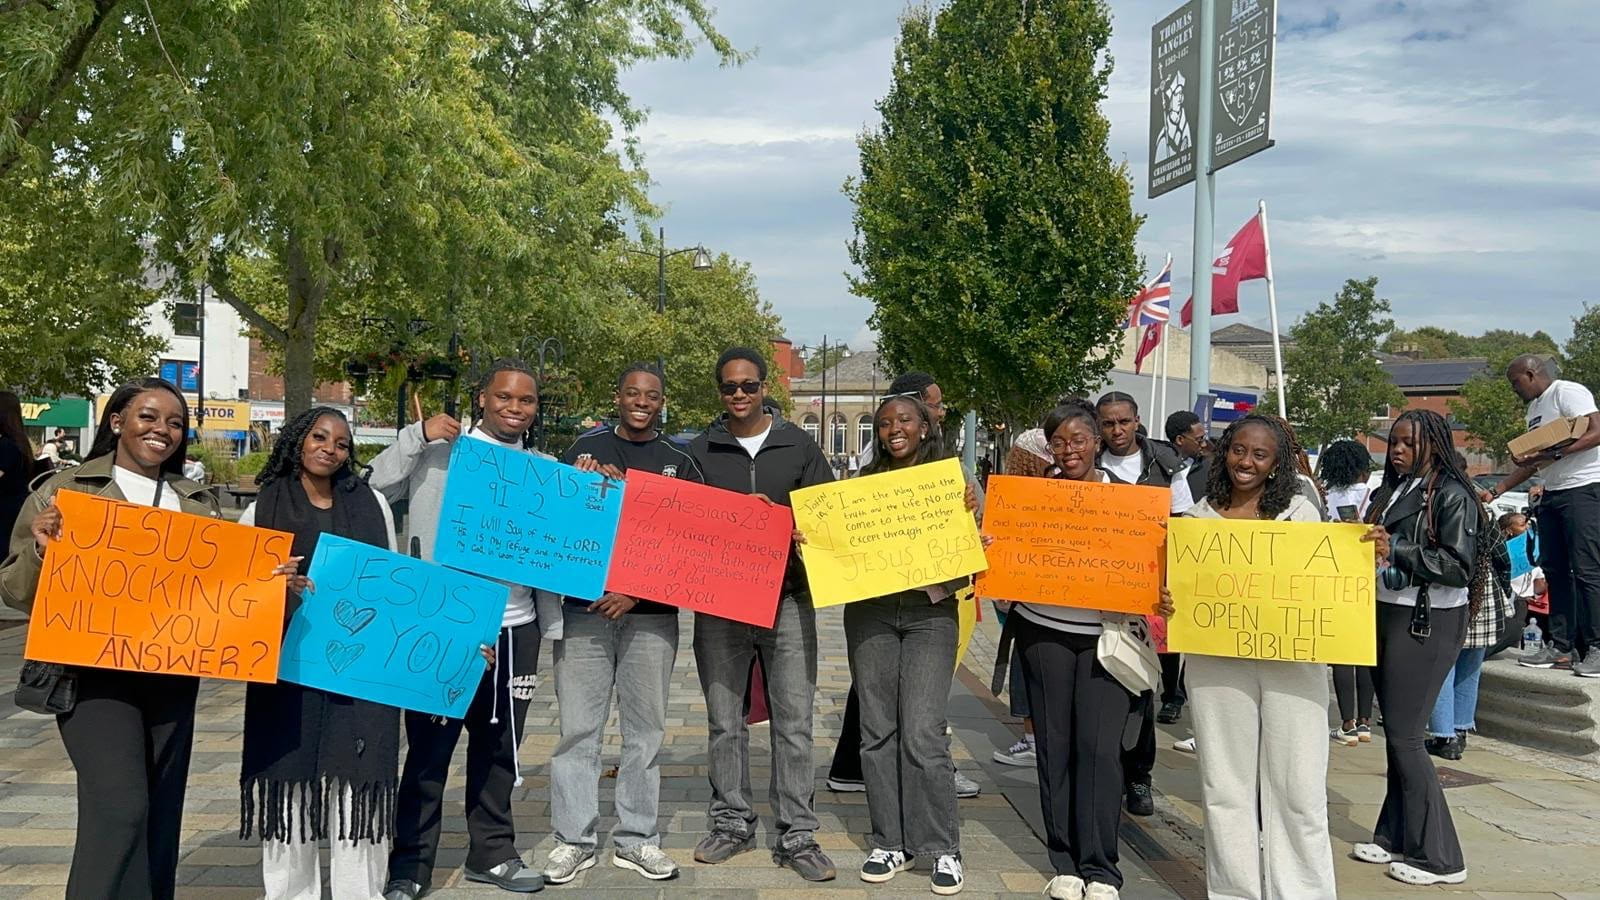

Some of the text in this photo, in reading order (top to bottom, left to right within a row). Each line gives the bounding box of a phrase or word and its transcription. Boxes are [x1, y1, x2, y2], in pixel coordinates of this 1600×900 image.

[1160, 10, 1192, 42] THOMAS
[1158, 25, 1194, 58] LANGLEY
[454, 436, 579, 498] PSALMS
[851, 497, 866, 505] am
[872, 489, 889, 501] the
[918, 482, 937, 491] and
[939, 478, 957, 487] the
[1046, 480, 1093, 493] Matthew
[633, 480, 738, 523] Ephesians
[843, 509, 868, 520] truth
[870, 506, 883, 514] and
[886, 503, 898, 511] the
[944, 491, 963, 501] one
[1021, 505, 1038, 513] and
[451, 504, 474, 525] I
[527, 528, 537, 537] of
[543, 533, 557, 544] the
[845, 508, 955, 532] comes to the Father
[992, 519, 1011, 528] and
[1112, 527, 1125, 535] the
[71, 497, 284, 581] JESUS IS
[506, 540, 530, 554] refuge
[723, 539, 742, 552] you
[883, 529, 922, 541] through
[1030, 536, 1054, 545] open
[624, 546, 648, 560] that
[677, 557, 689, 570] of
[672, 543, 713, 563] through
[834, 534, 978, 582] JESUS BLESS
[1016, 553, 1039, 567] UK
[1042, 554, 1076, 568] PCEA
[1172, 531, 1340, 573] WANT A
[50, 551, 258, 619] KNOCKING
[622, 557, 638, 570] the
[667, 568, 678, 579] of
[684, 572, 706, 585] God
[328, 554, 478, 625] JESUS
[1194, 571, 1371, 606] LOVE LETTER
[44, 597, 220, 648] WILL YOU
[1193, 602, 1336, 637] OPEN THE
[1236, 631, 1317, 661] BIBLE!
